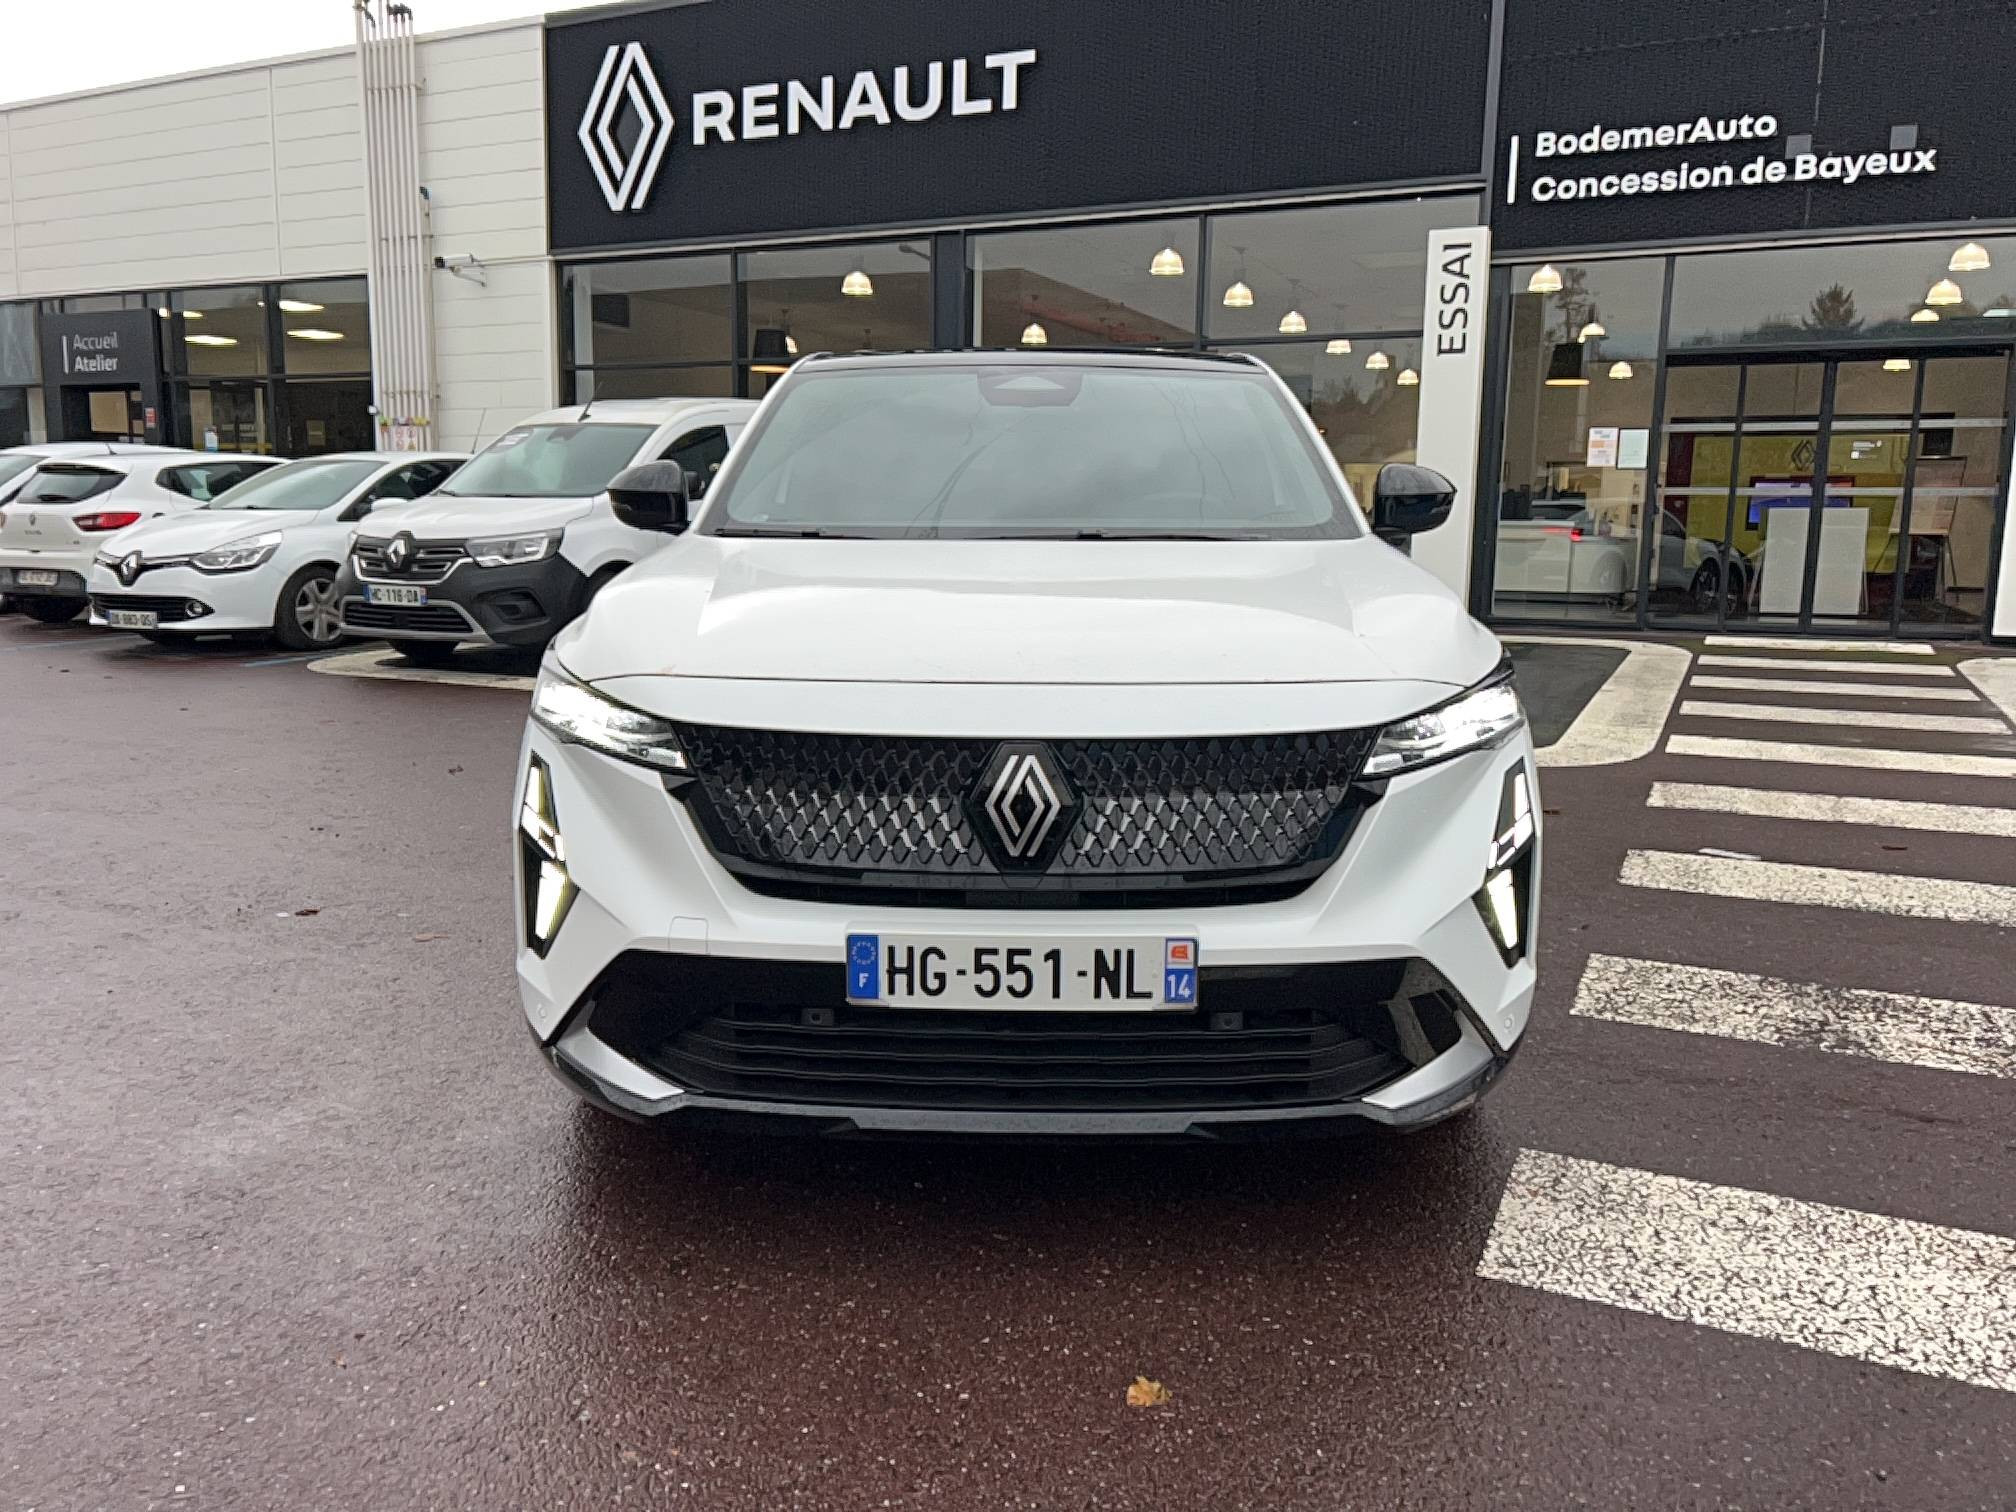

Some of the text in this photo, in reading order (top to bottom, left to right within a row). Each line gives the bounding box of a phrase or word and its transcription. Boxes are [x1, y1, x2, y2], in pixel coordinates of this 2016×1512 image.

[692, 48, 1037, 146] RENAULT
[1535, 114, 1778, 157] BodemerAuto
[1532, 149, 1937, 202] Concession de Bayeux
[1437, 242, 1472, 357] ESSAI
[73, 331, 119, 350] Accueil
[75, 354, 118, 372] Atelier
[858, 945, 1192, 1000] F HG-551-NL 14
